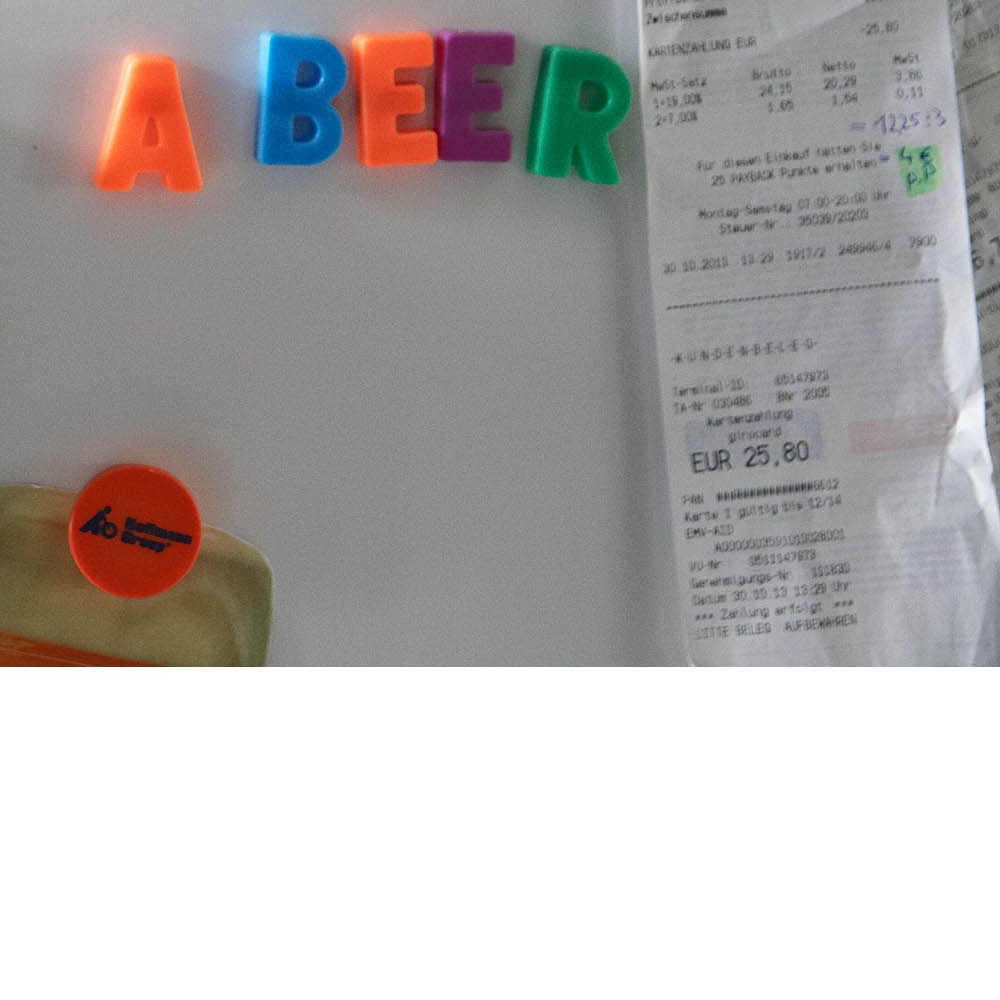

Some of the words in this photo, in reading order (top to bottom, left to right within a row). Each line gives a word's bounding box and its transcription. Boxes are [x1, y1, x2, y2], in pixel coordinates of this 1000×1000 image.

[93, 52, 204, 193] A
[253, 28, 633, 187] BEER
[690, 449, 732, 474] EUR
